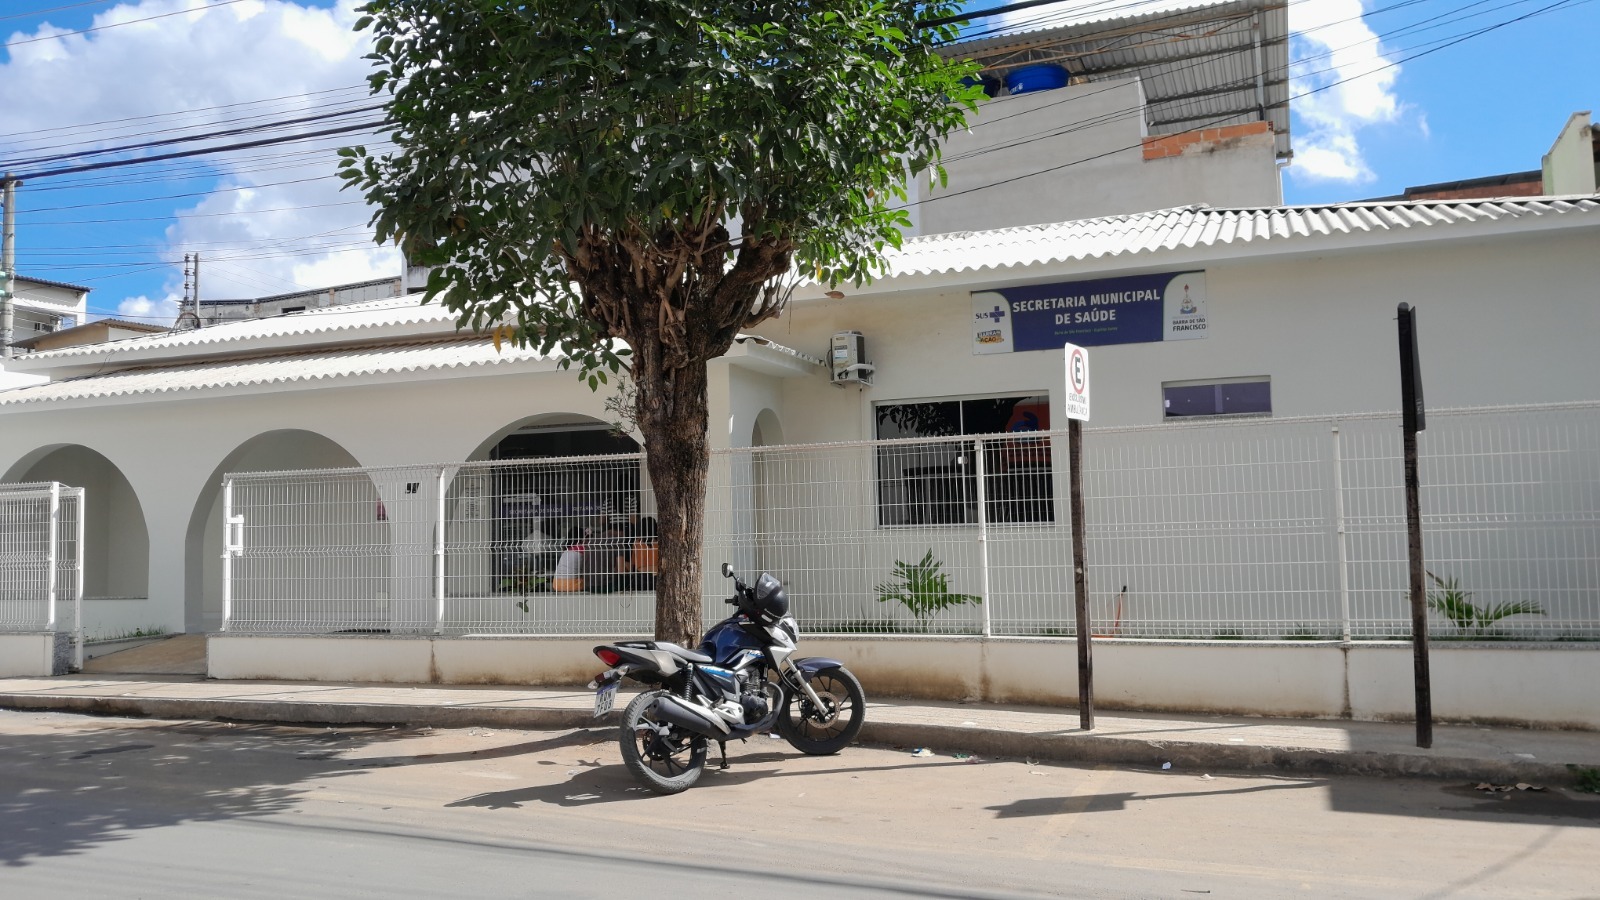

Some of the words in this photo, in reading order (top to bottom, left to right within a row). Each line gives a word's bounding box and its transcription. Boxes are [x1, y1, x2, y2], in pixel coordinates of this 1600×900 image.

[1012, 296, 1087, 313] SECRETARIA
[1090, 289, 1161, 306] MUNICIPAL
[975, 312, 989, 320] SUS
[1055, 313, 1071, 325] DE
[1074, 307, 1116, 324] SAÚDE
[1172, 323, 1207, 332] FRANCISCO
[1074, 356, 1082, 385] E
